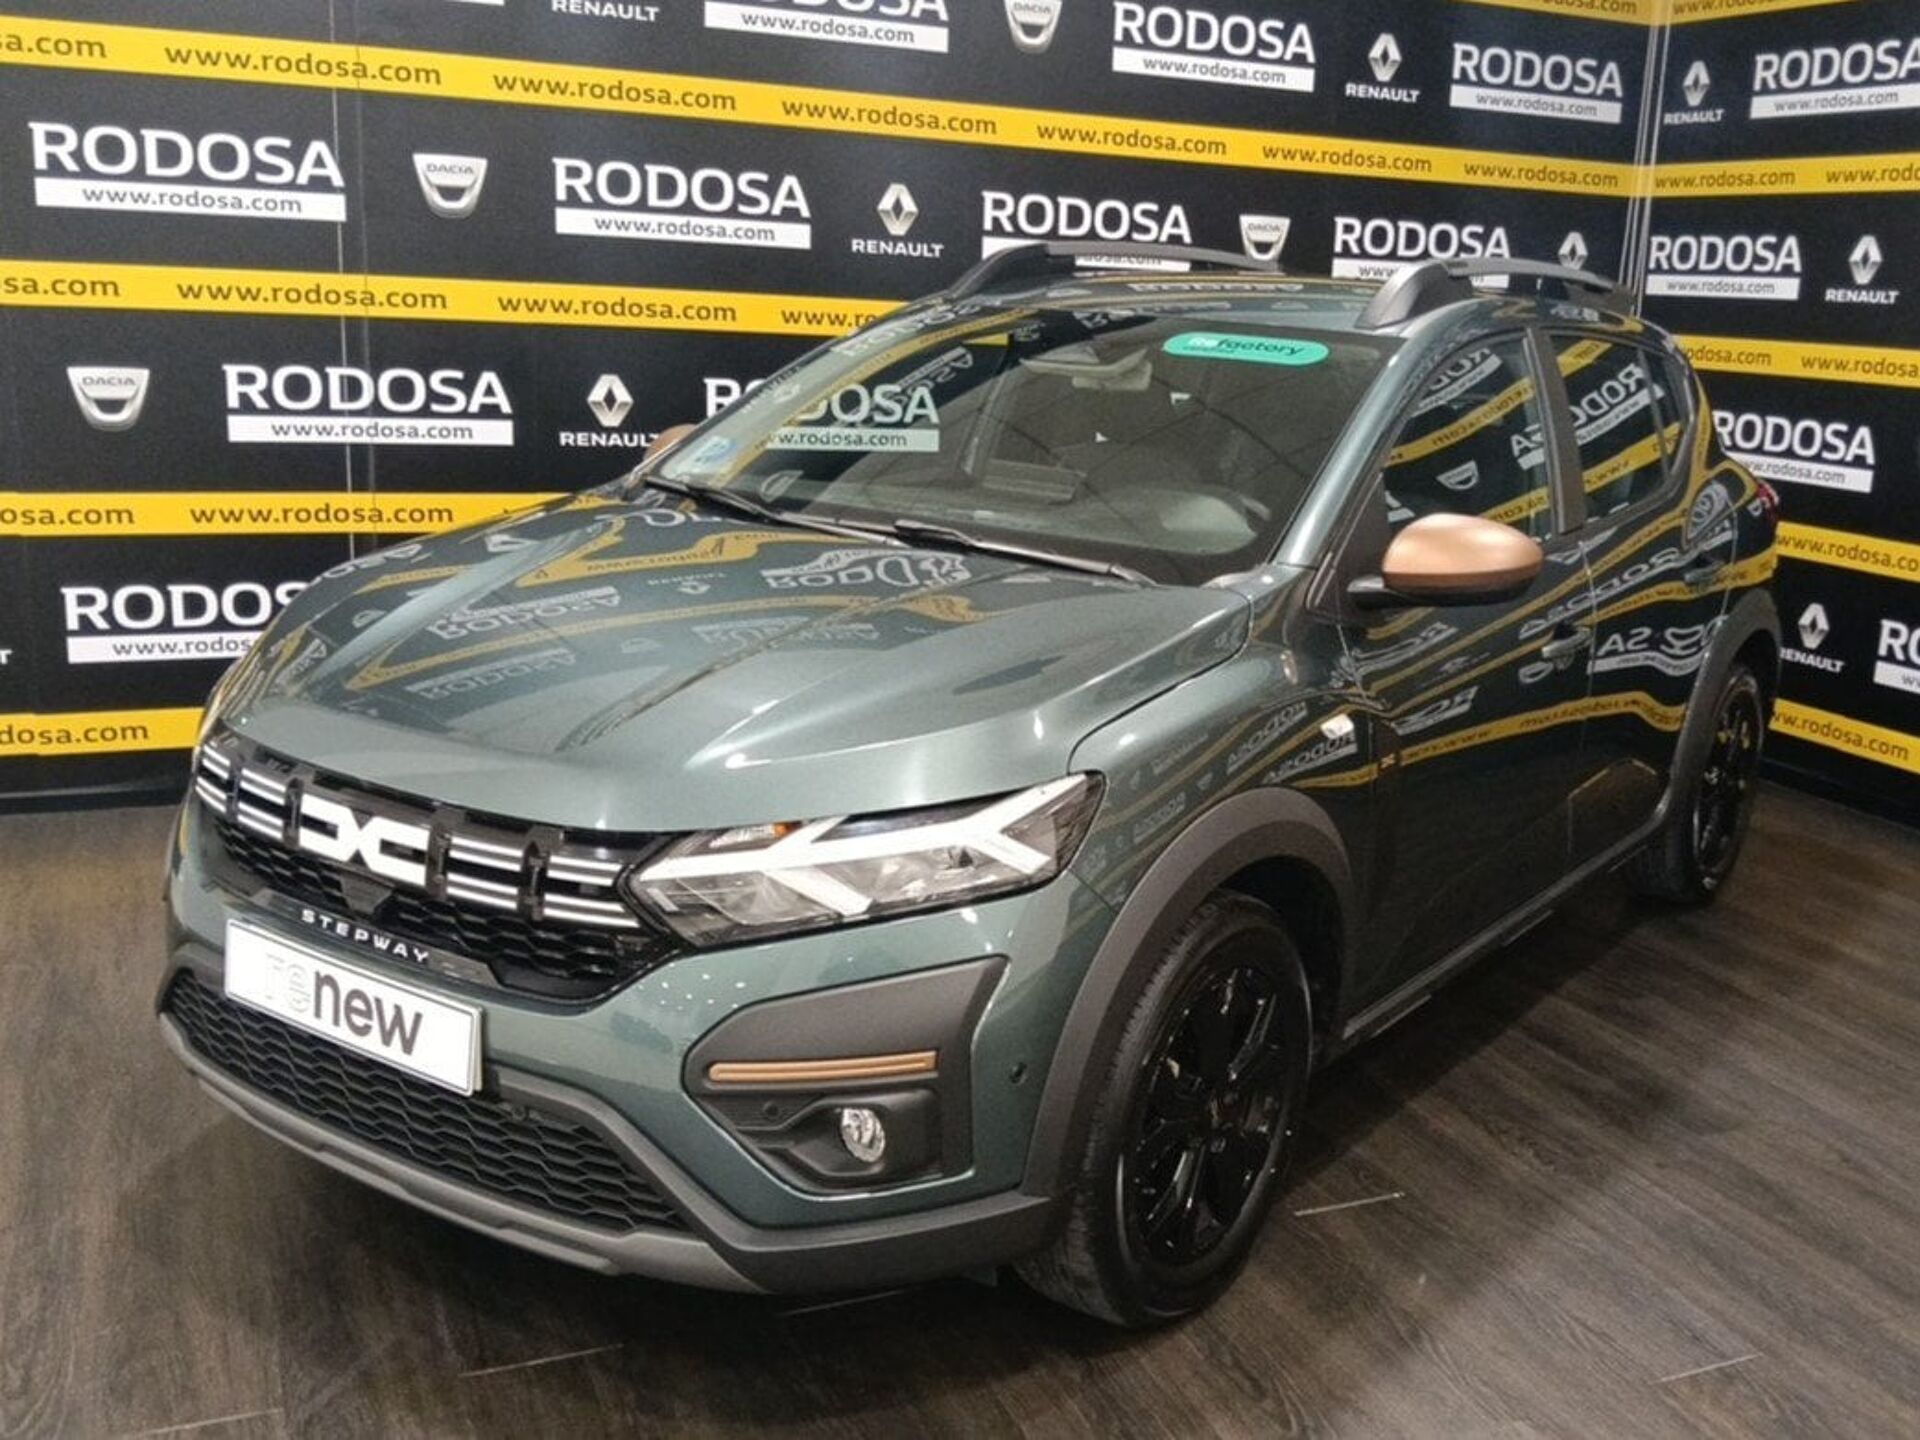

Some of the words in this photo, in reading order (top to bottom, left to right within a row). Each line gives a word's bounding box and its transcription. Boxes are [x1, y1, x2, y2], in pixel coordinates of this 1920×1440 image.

[550, 0, 660, 22] RENAULT
[1013, 2, 1052, 15] DACIA
[740, 11, 916, 44] www.rodosa.com
[1112, 1, 1316, 64] RODOSA
[164, 44, 442, 86] www.rodosa.com
[1142, 56, 1287, 85] www.rodosa.com
[1453, 43, 1624, 98] RODOSA
[1753, 38, 1920, 91] RODOSA
[493, 72, 737, 111] www.rodosa.com
[1345, 83, 1420, 103] RENAULT
[1475, 93, 1598, 117] www.rodosa.com
[1773, 90, 1899, 113] www.rodosa.com
[782, 99, 998, 135] www.rodosa.com
[1664, 108, 1725, 125] RENAULT
[1036, 122, 1227, 156] www.rodosa.com
[28, 121, 346, 187] RODOSA
[426, 162, 474, 175] DACIA
[1262, 142, 1433, 173] www.rodosa.com
[552, 157, 811, 219] RODOSA
[1463, 160, 1619, 188] www.rodosa.com
[1654, 170, 1796, 189] www.rodosa.com
[81, 186, 302, 214] www.rodosa.com
[595, 216, 776, 242] www.rodosa.com
[981, 190, 1193, 245] RODOSA
[851, 239, 945, 258] RENAULT
[1334, 217, 1512, 260] RODOSA
[1648, 235, 1802, 273] RODOSA
[177, 282, 448, 311] www.rodosa.com
[1666, 279, 1775, 295] www.rodosa.com
[1825, 288, 1899, 305] RENAULT
[498, 296, 737, 323] www.rodosa.com
[82, 377, 135, 387] DACIA
[222, 364, 513, 414] RODOSA
[271, 421, 474, 440] www.rodosa.com
[1712, 410, 1875, 465] RODOSA
[190, 502, 453, 525] www.rodosa.com
[302, 908, 430, 963] STEPWAY
